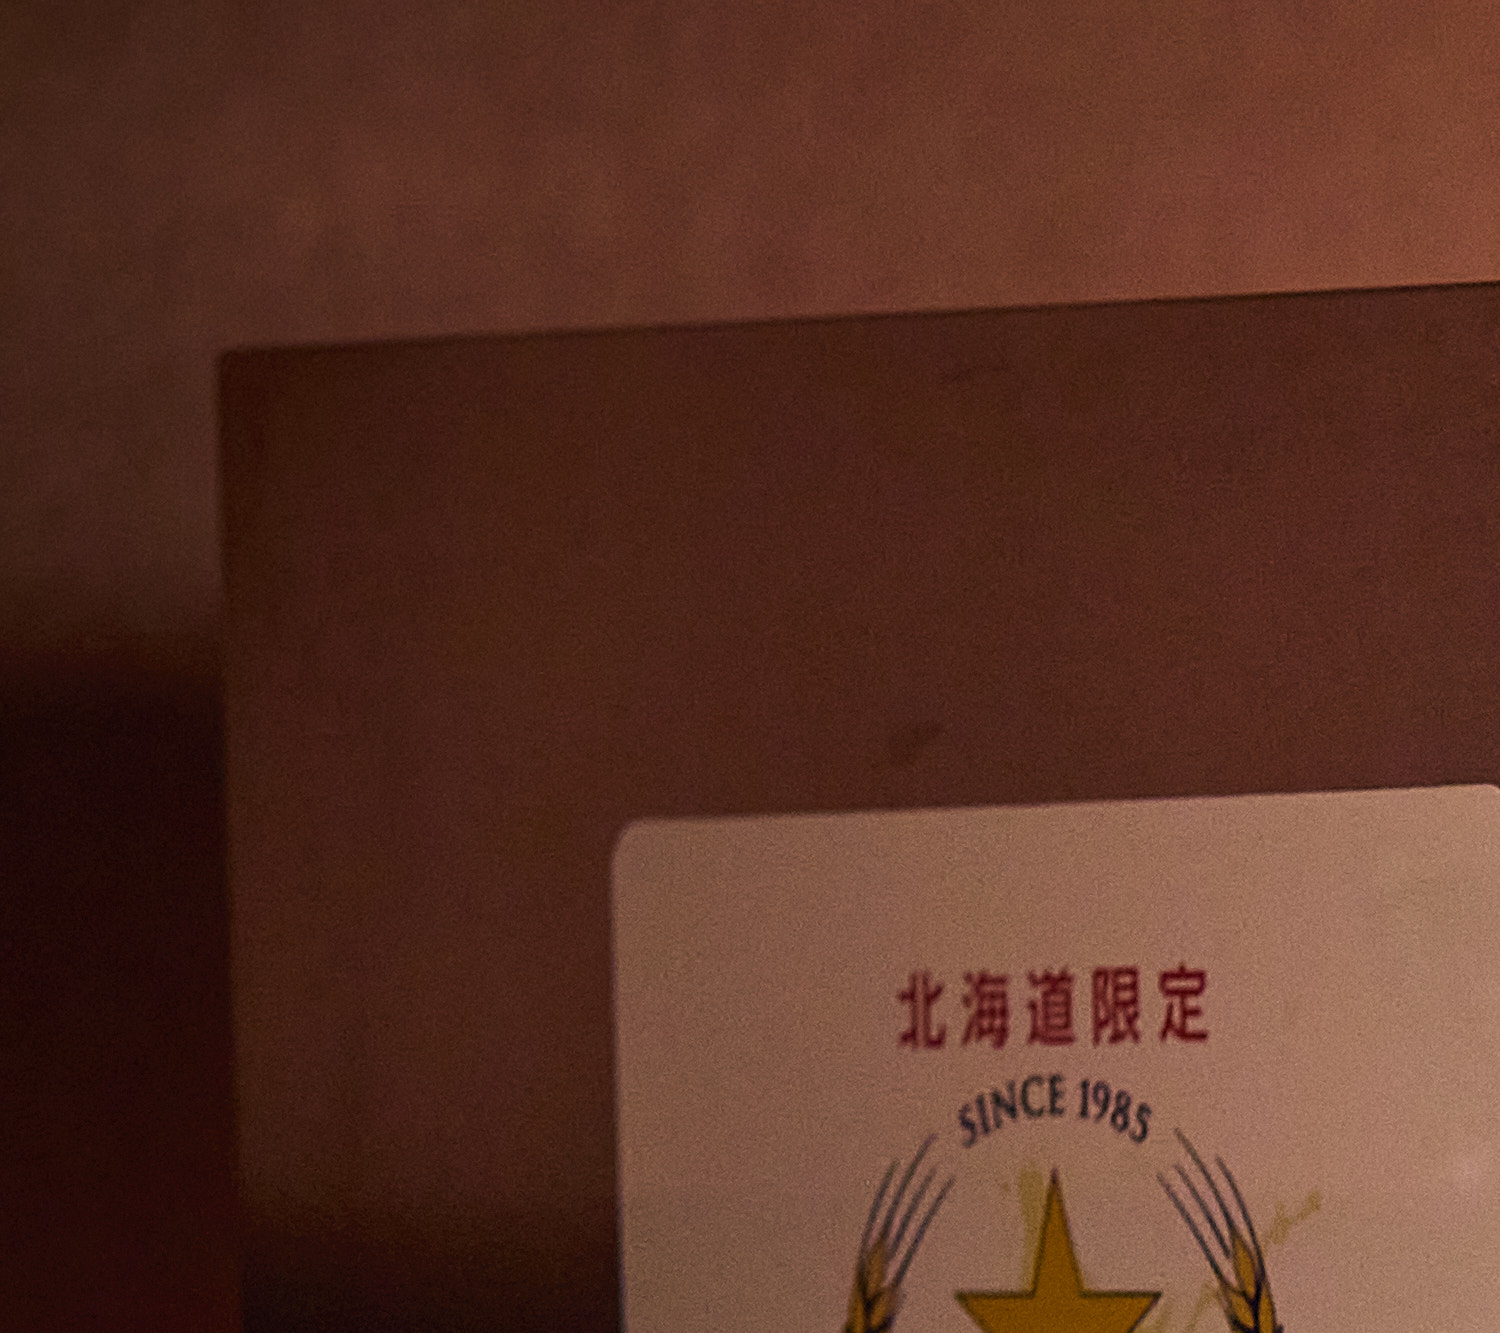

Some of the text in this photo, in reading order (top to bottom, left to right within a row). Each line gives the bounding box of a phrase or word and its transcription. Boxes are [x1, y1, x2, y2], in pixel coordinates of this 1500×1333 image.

[898, 962, 1208, 1049] 北海道限定
[957, 1073, 1152, 1149] SINCE 1985
